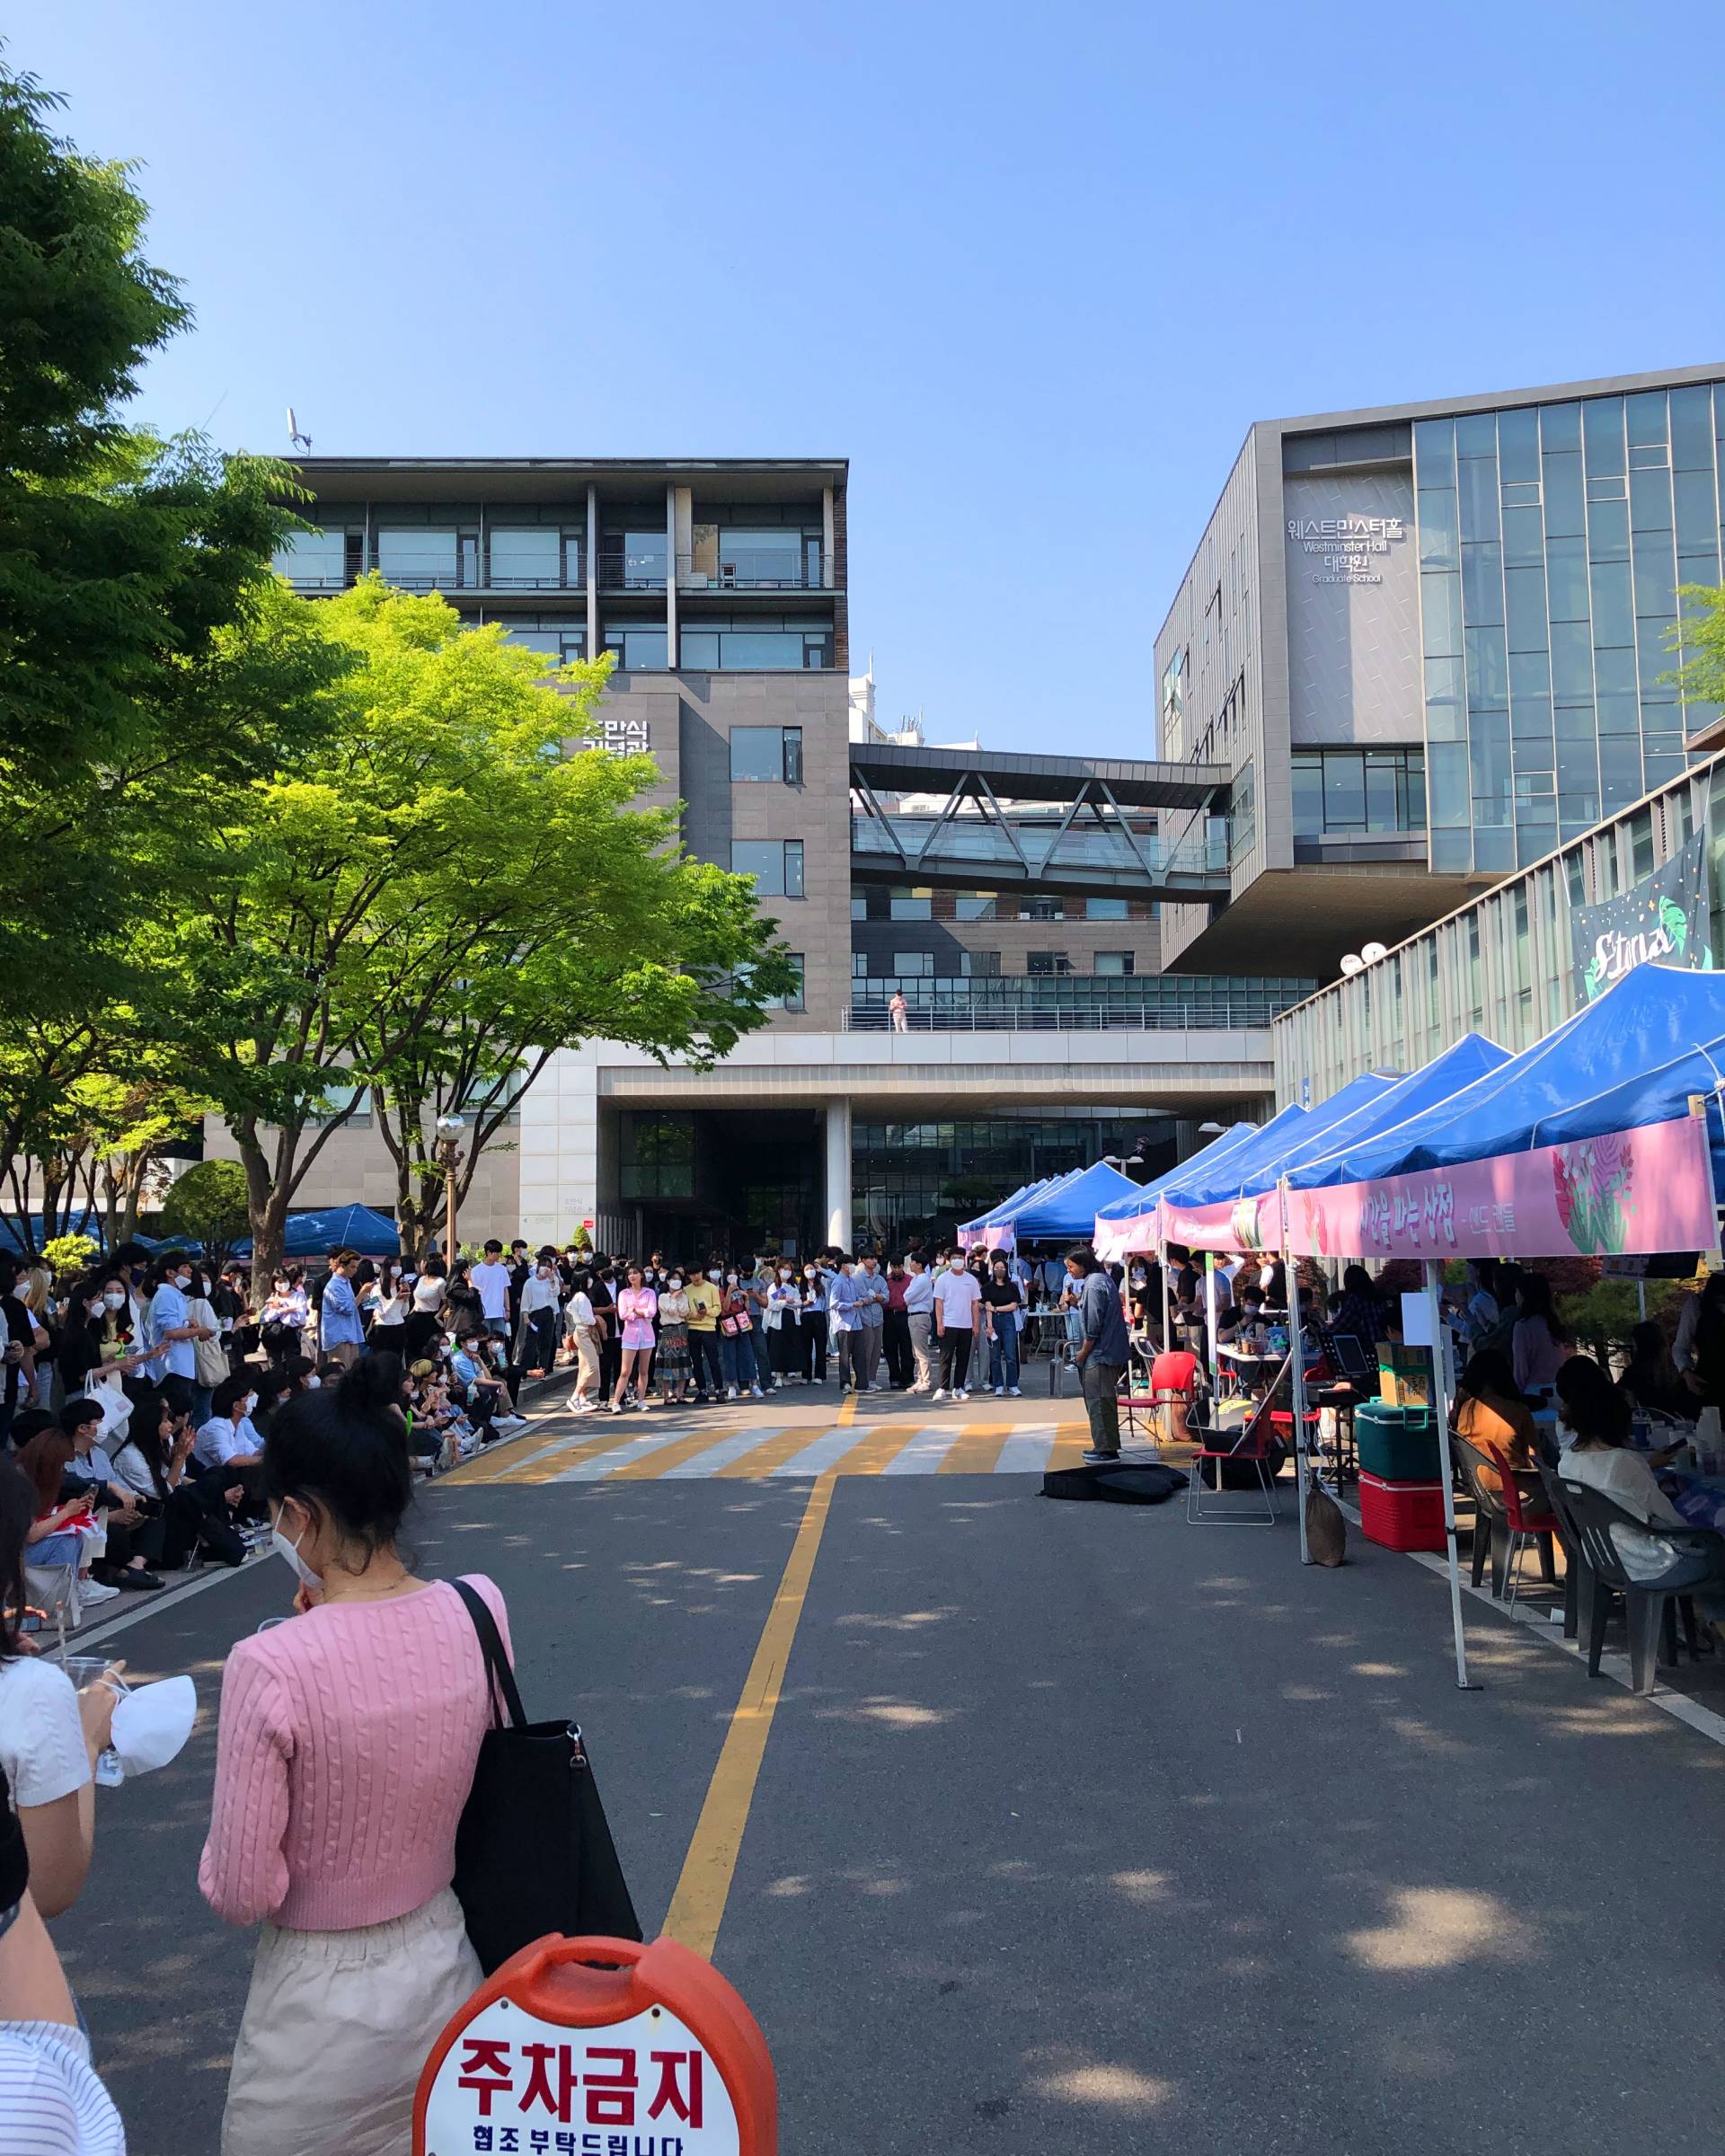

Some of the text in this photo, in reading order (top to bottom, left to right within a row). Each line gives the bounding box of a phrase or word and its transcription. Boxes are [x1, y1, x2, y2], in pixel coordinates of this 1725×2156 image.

[1288, 517, 1402, 540] 웨스트민스터홀
[1304, 541, 1387, 552] Westminster Hall
[1324, 554, 1368, 572] 대학원
[1312, 574, 1381, 583] Graduate School
[1393, 1186, 1420, 1242] 파는
[1424, 1181, 1455, 1242] 상점
[457, 2038, 703, 2129] 주차금지
[473, 2125, 684, 2156] 협조 부탁드립니다
